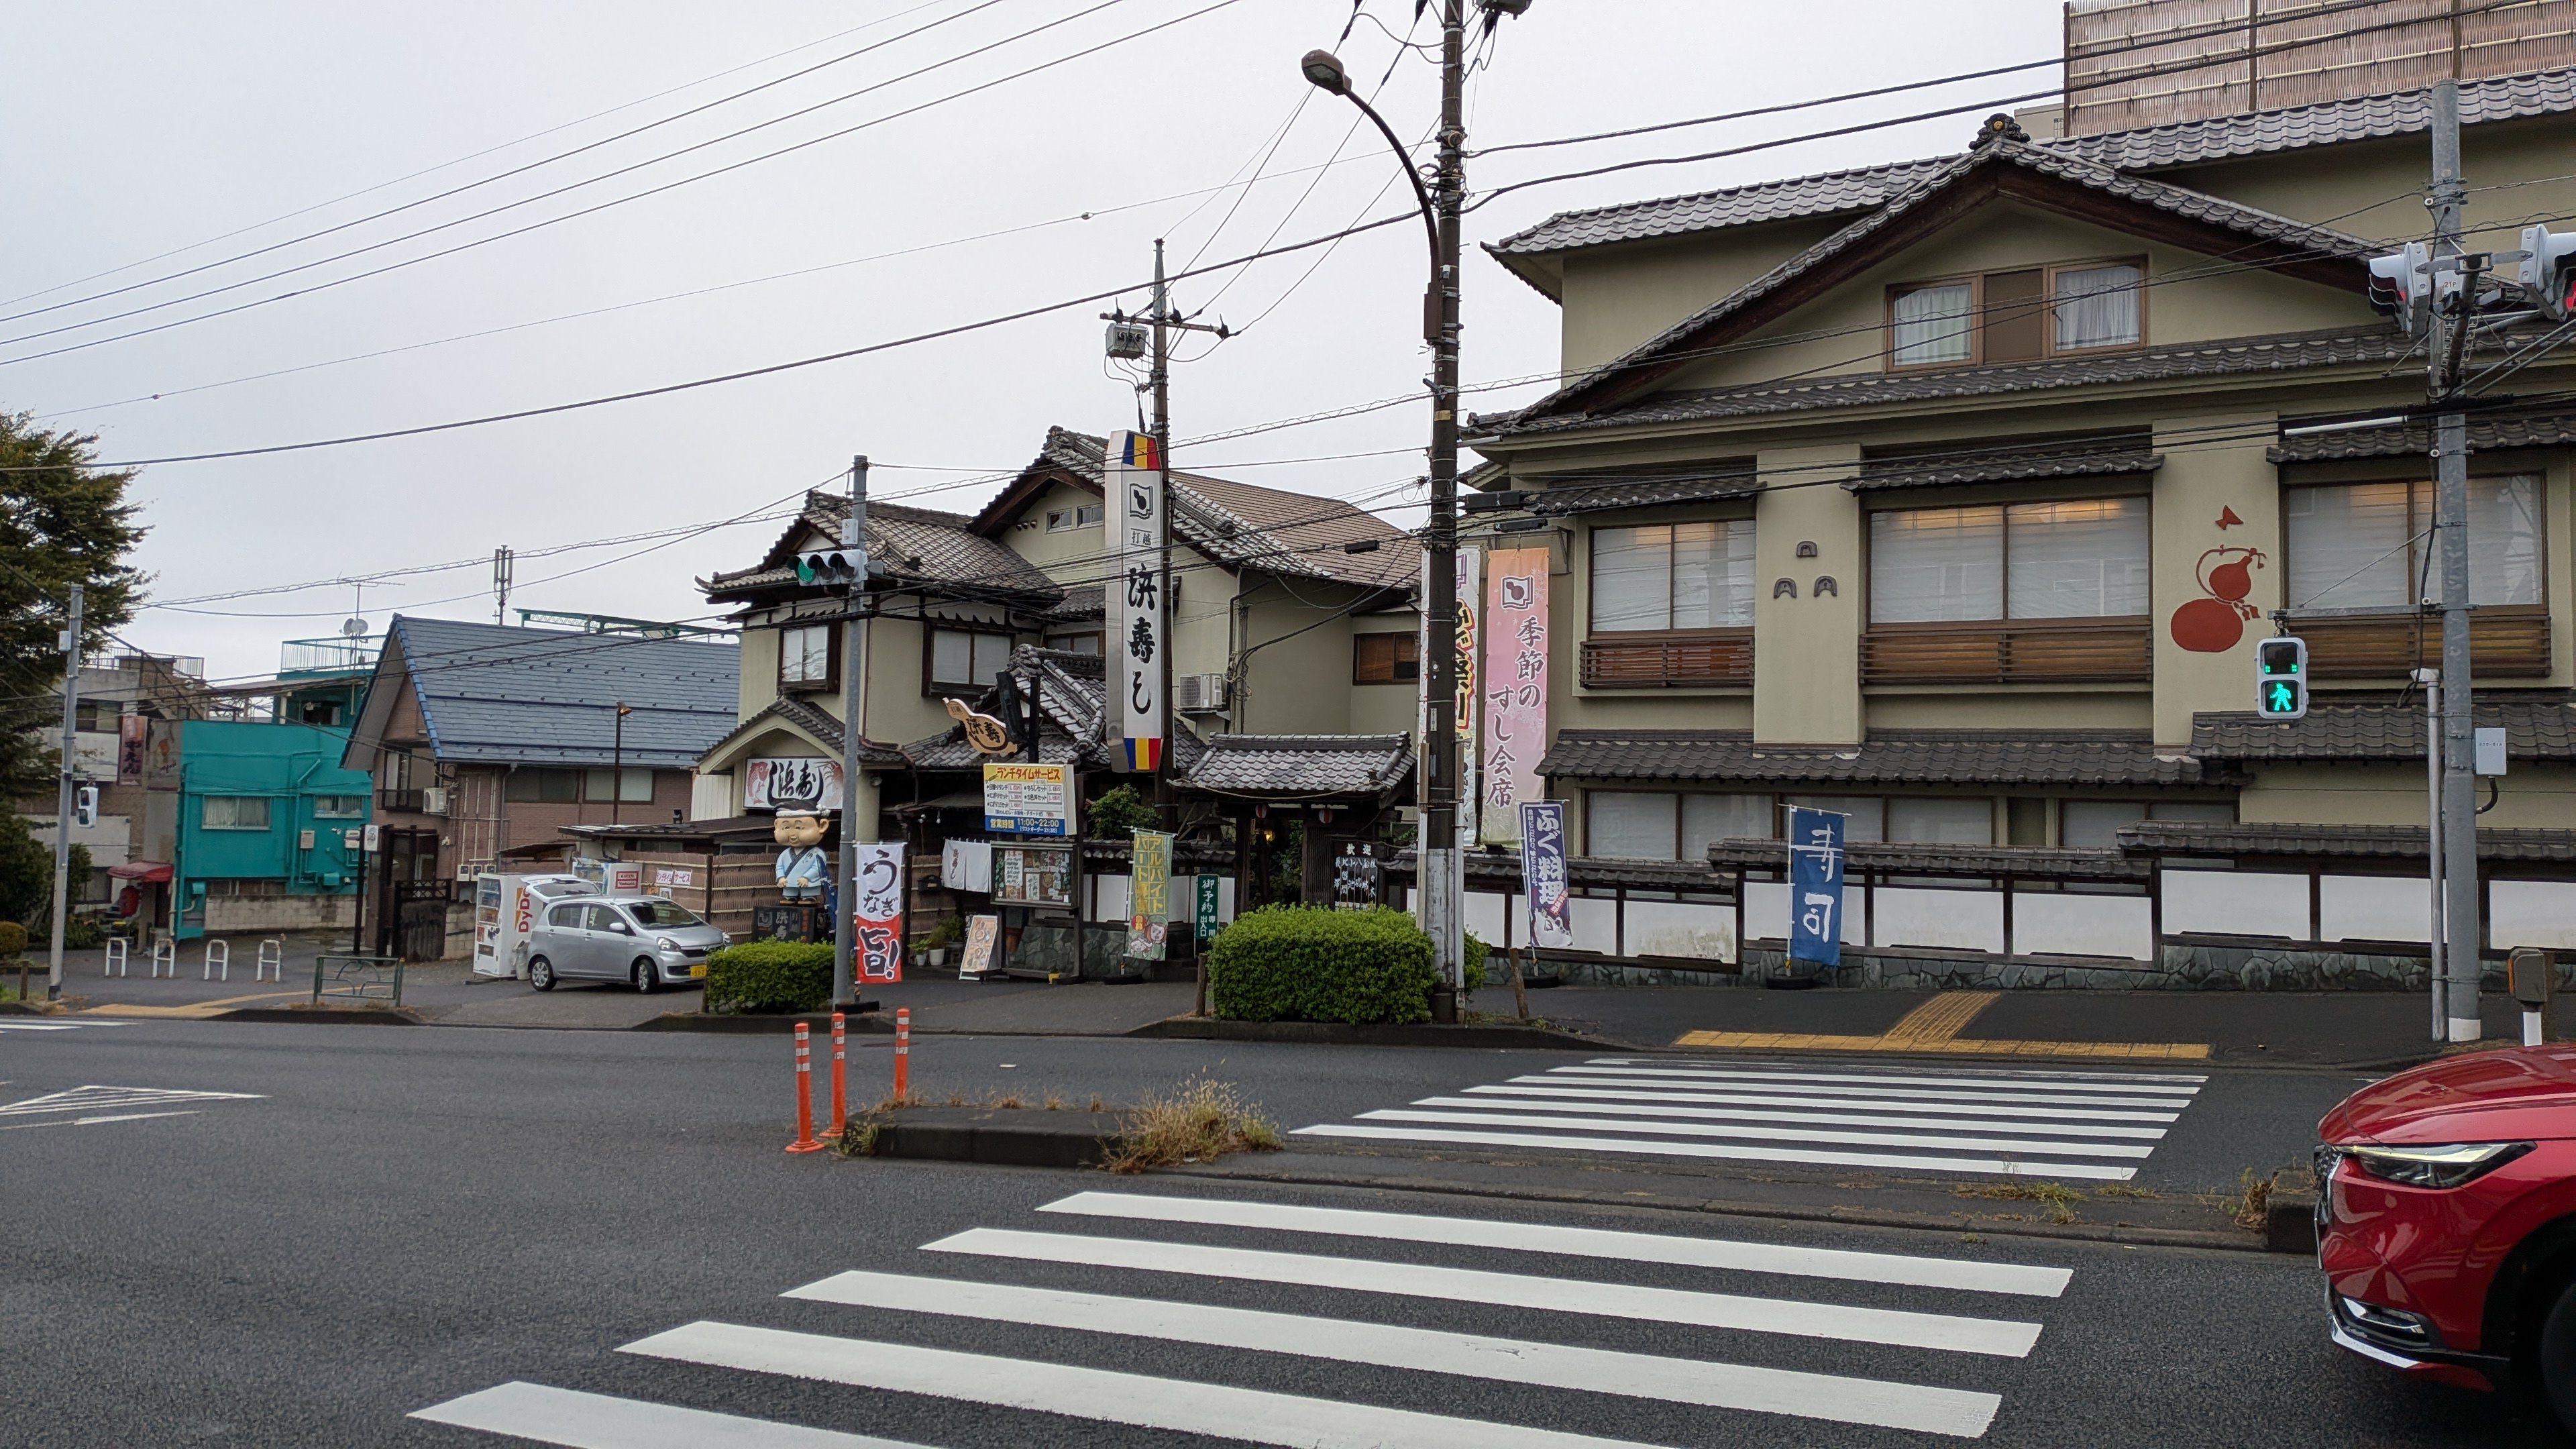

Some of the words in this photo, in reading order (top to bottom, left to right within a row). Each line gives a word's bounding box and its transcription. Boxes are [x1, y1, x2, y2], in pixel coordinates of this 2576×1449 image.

[1517, 616, 1544, 708] 季節の
[997, 767, 1061, 781] ランチタイムサービス
[1486, 686, 1516, 808] すし会席
[862, 849, 899, 918] うなぎ
[1150, 837, 1163, 913] アルバイト
[1536, 808, 1564, 905] ふぐ料理
[1791, 823, 1844, 943] 寿司
[1199, 914, 1208, 937] 出入口
[1201, 879, 1216, 913] 御予約
